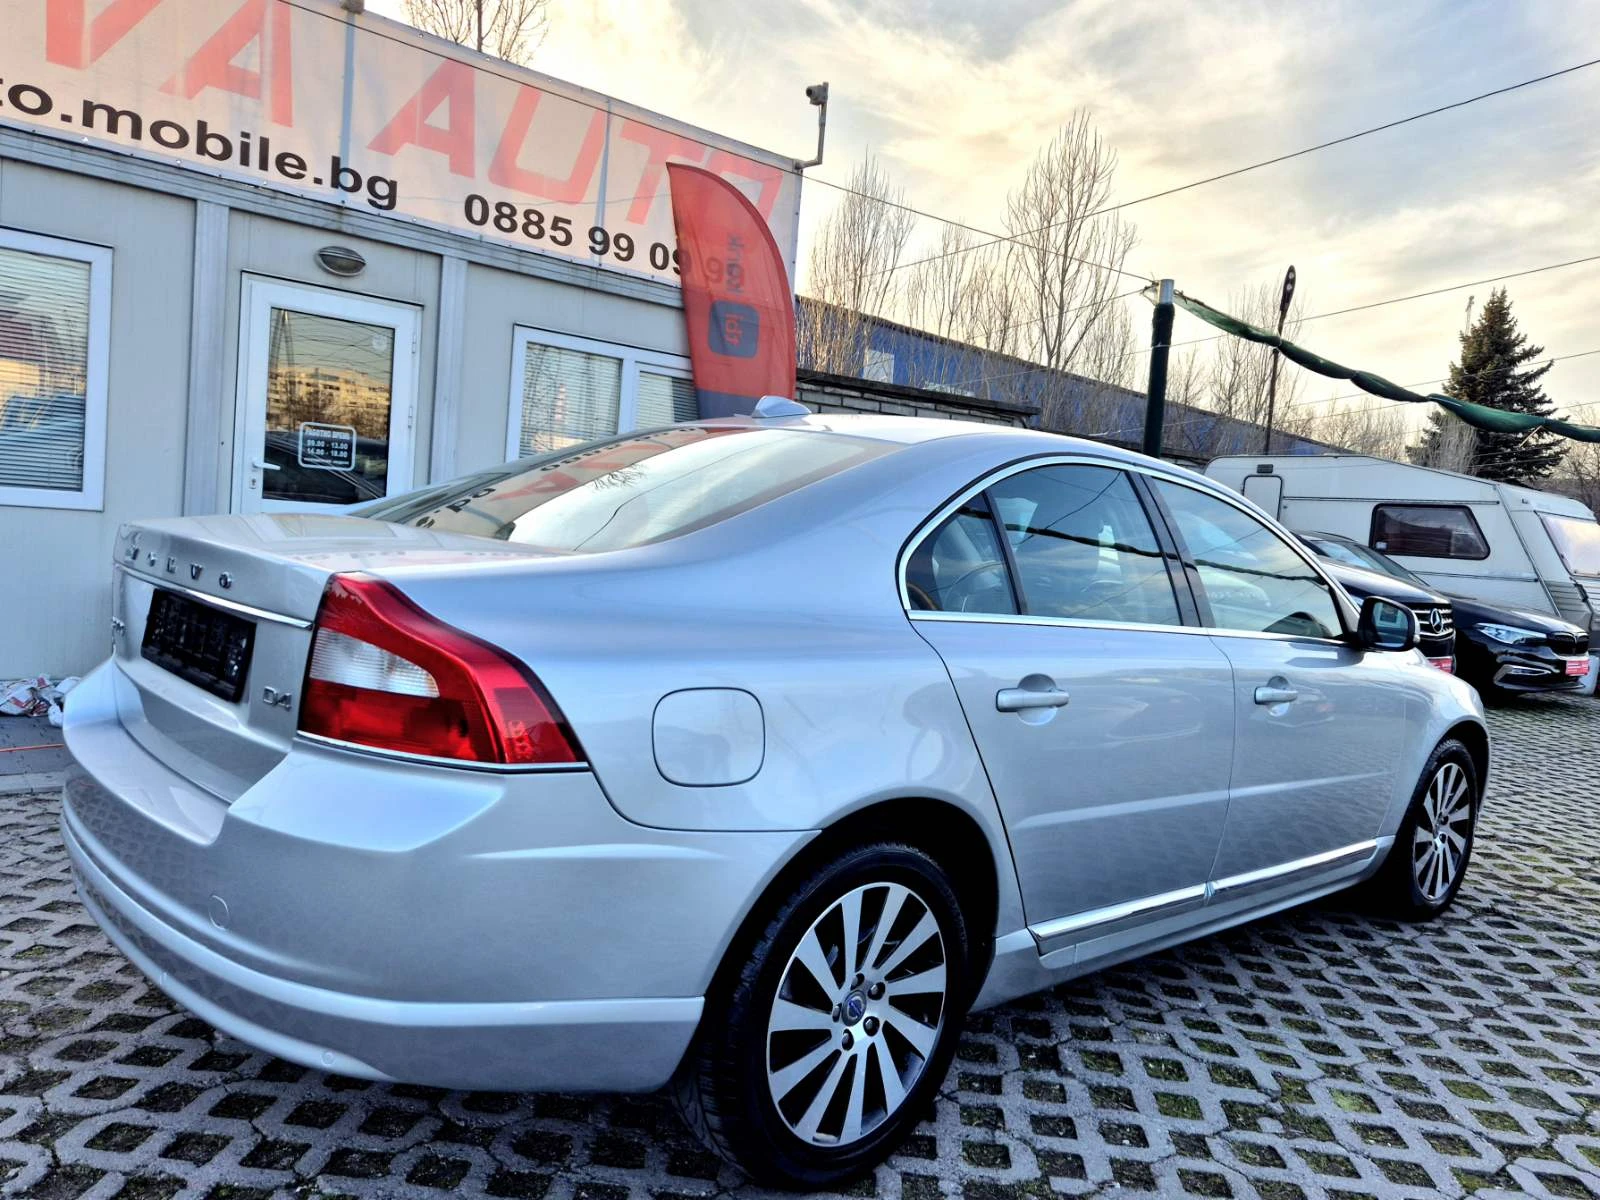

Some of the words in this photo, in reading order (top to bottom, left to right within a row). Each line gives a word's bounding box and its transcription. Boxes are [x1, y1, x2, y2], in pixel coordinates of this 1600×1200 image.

[0, 78, 398, 211] o.mobile.bg
[464, 193, 573, 246] 0885
[588, 226, 635, 262] 99
[263, 686, 292, 712] D4
